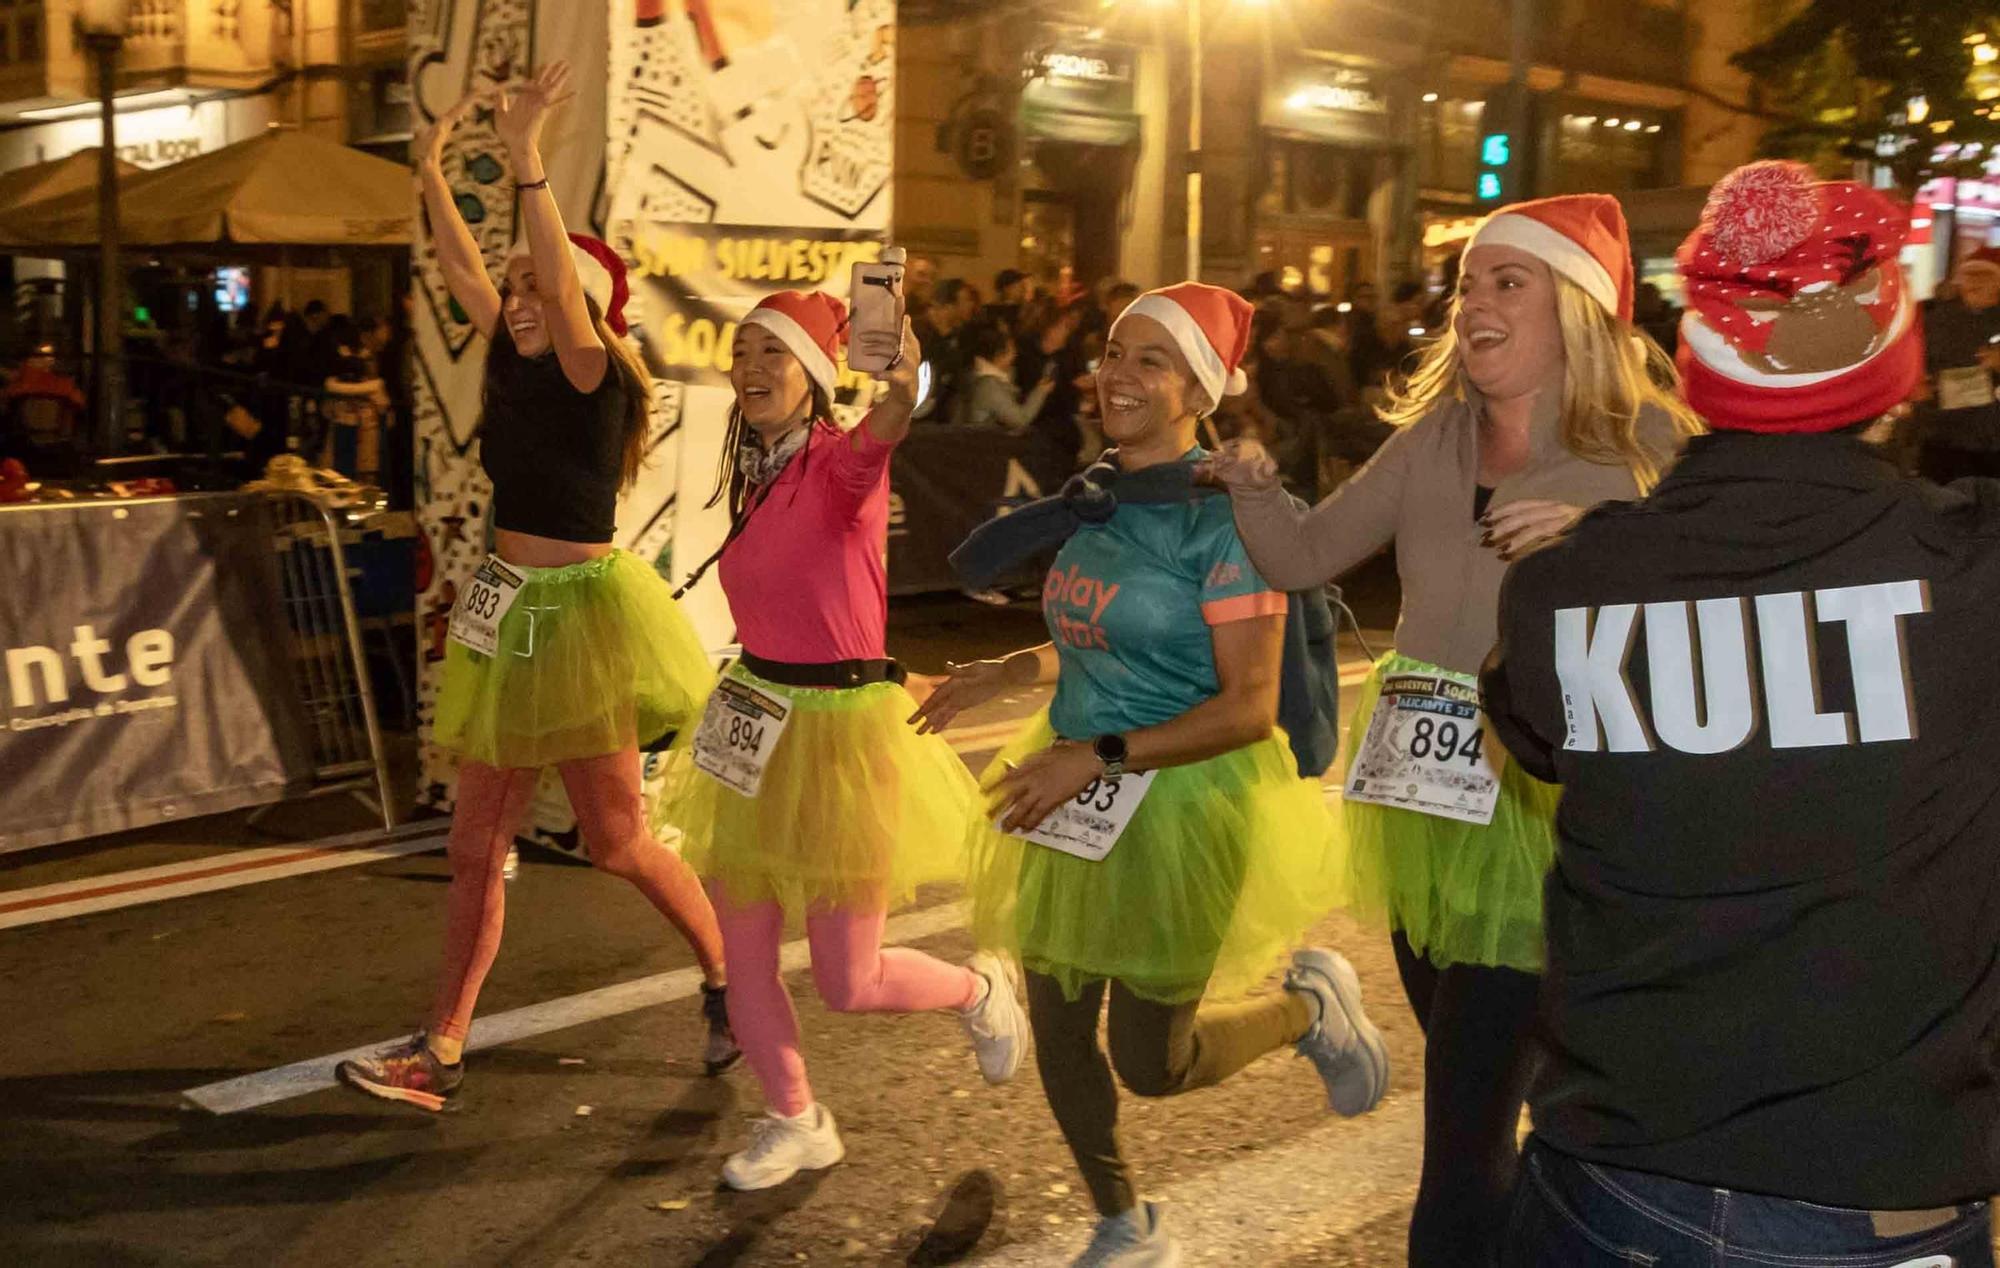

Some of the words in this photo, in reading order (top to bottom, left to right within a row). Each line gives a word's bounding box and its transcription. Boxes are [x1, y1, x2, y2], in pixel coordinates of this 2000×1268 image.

[467, 582, 500, 620] 893
[1042, 562, 1121, 624] play
[5, 624, 176, 708] nte
[1554, 579, 1932, 754] KULT
[1399, 697, 1453, 714] ALICANTE
[729, 715, 765, 757] 894
[1410, 716, 1485, 767] 894
[1075, 776, 1121, 812] 93
